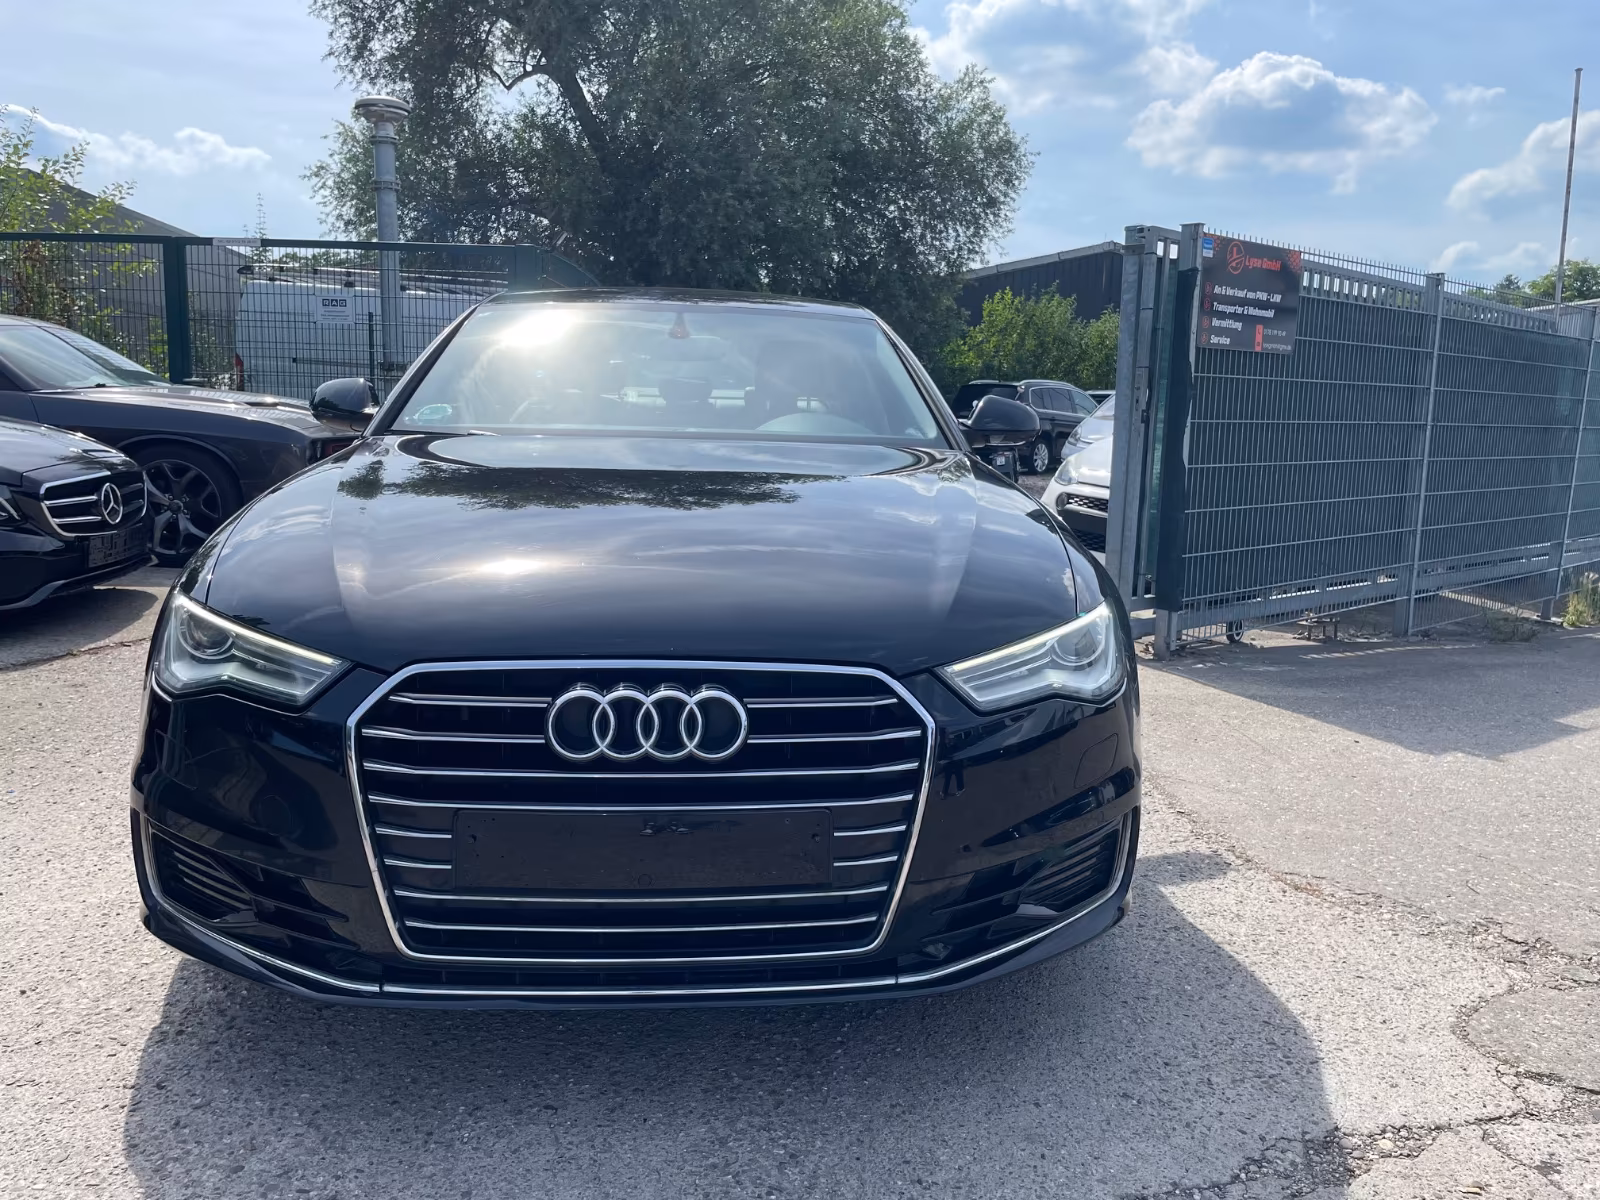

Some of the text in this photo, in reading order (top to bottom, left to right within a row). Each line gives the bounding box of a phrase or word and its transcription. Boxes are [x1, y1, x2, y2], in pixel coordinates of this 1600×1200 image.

[1262, 258, 1281, 271] GmbH
[1213, 285, 1221, 294] An
[1222, 286, 1227, 294] &
[1226, 287, 1247, 298] Verkauf
[1247, 291, 1256, 299] von
[1256, 291, 1268, 301] PKW
[1270, 294, 1281, 302] LKW
[1213, 302, 1274, 318] Transporter & Wohnmobil
[1212, 318, 1242, 331] Vermittlung
[1210, 334, 1230, 345] Service
